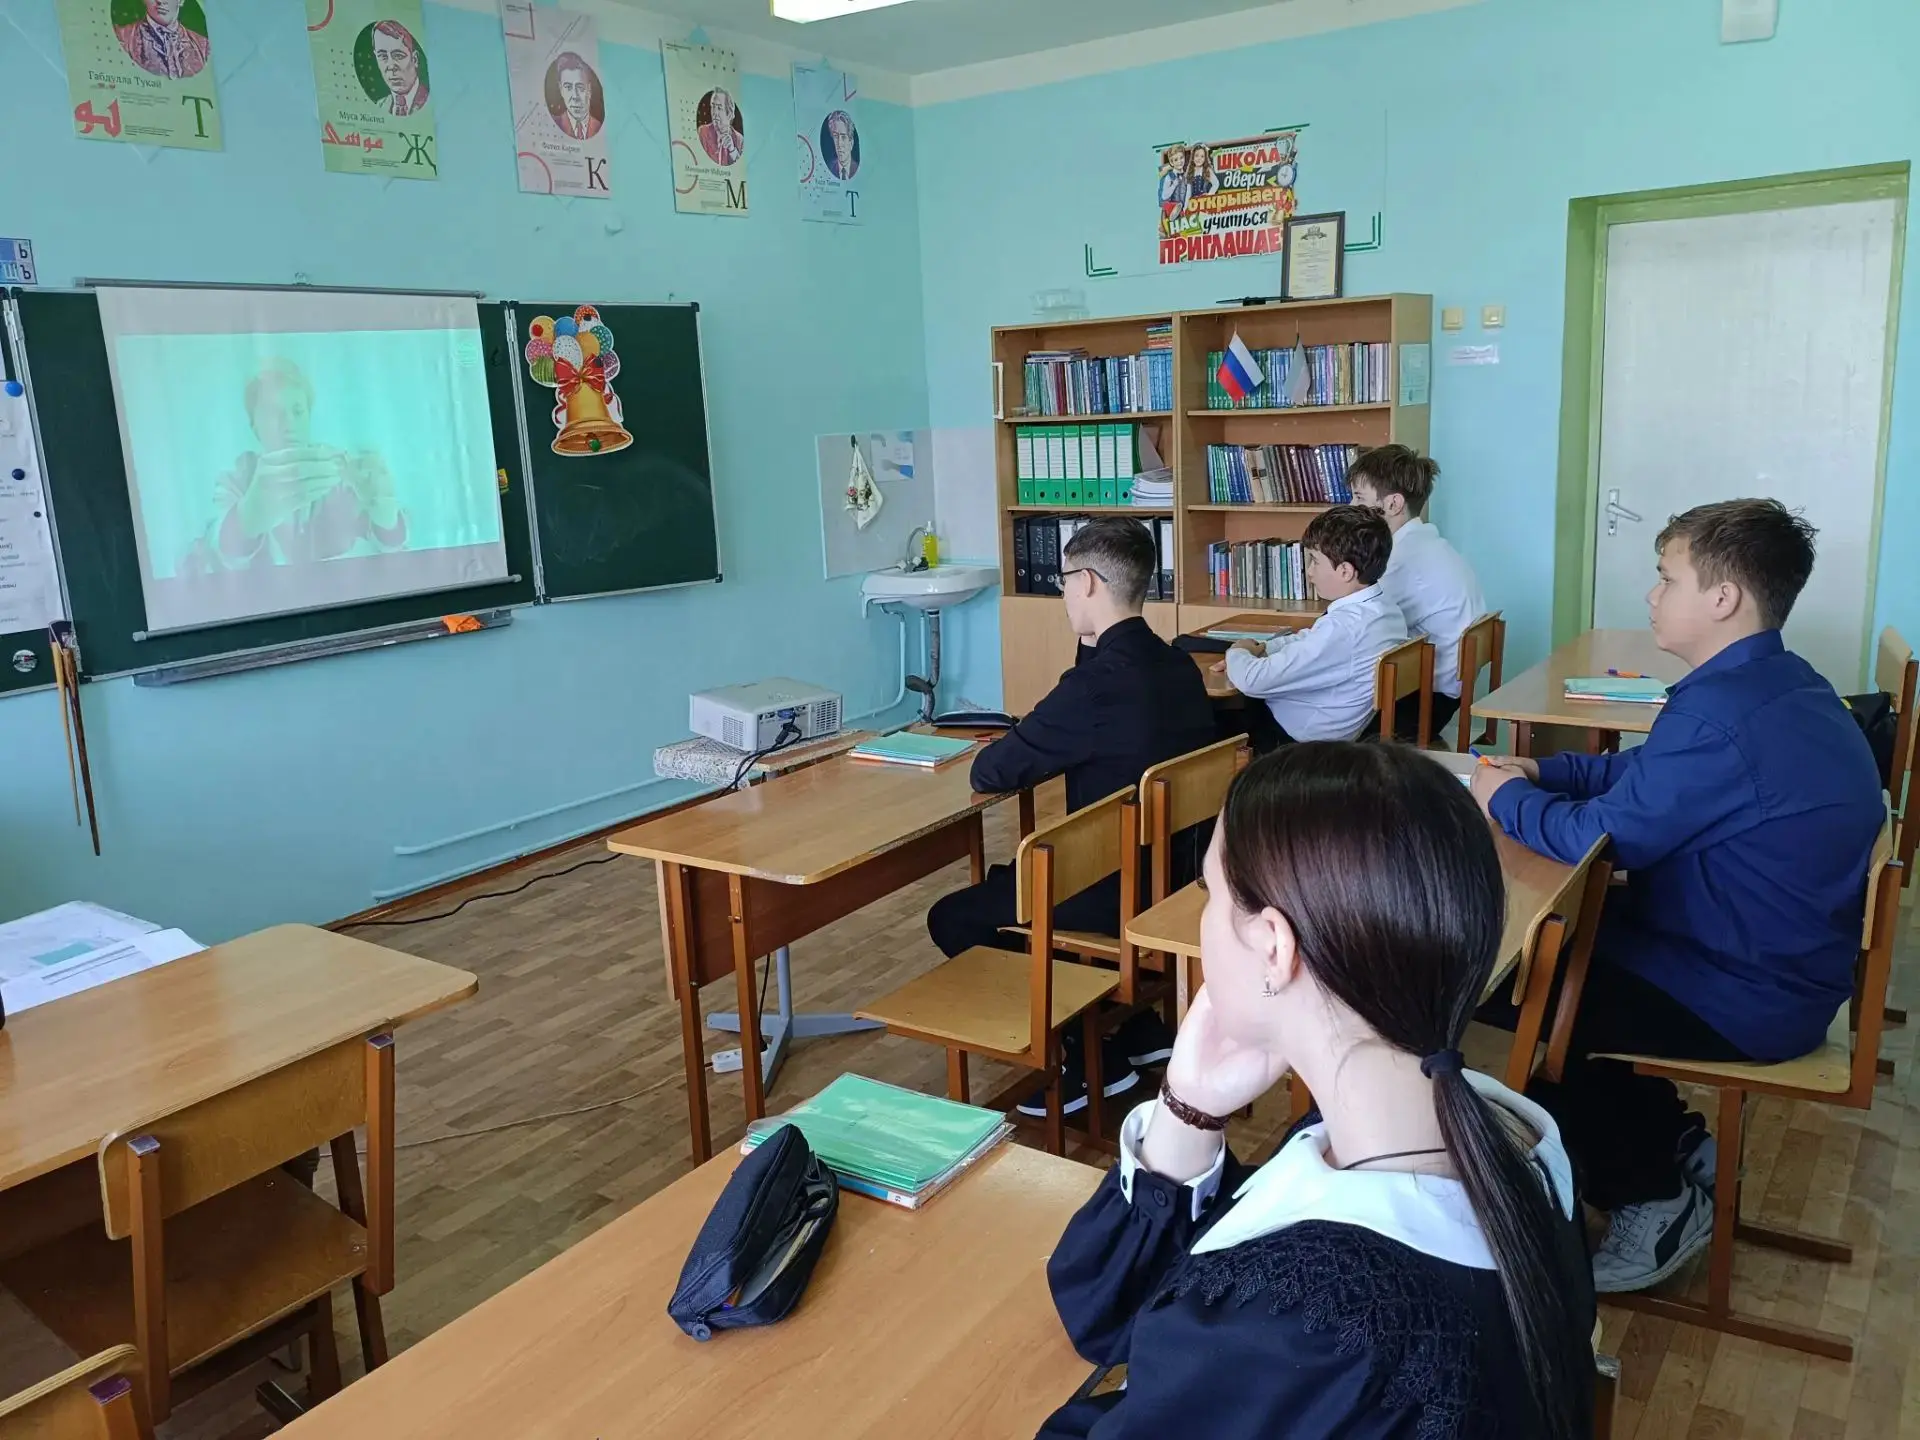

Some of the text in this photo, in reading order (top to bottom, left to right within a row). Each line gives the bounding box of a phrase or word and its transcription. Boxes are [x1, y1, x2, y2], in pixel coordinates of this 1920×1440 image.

[88, 71, 162, 89] Габдулла Тукай
[182, 95, 213, 138] Т
[1217, 147, 1280, 170] ШКОЛА
[584, 156, 609, 190] К
[1223, 169, 1266, 190] двери
[724, 179, 748, 210] М
[846, 190, 859, 217] Т
[1203, 211, 1268, 234] учиться
[1159, 228, 1281, 264] ПРИГЛАШАЕ
